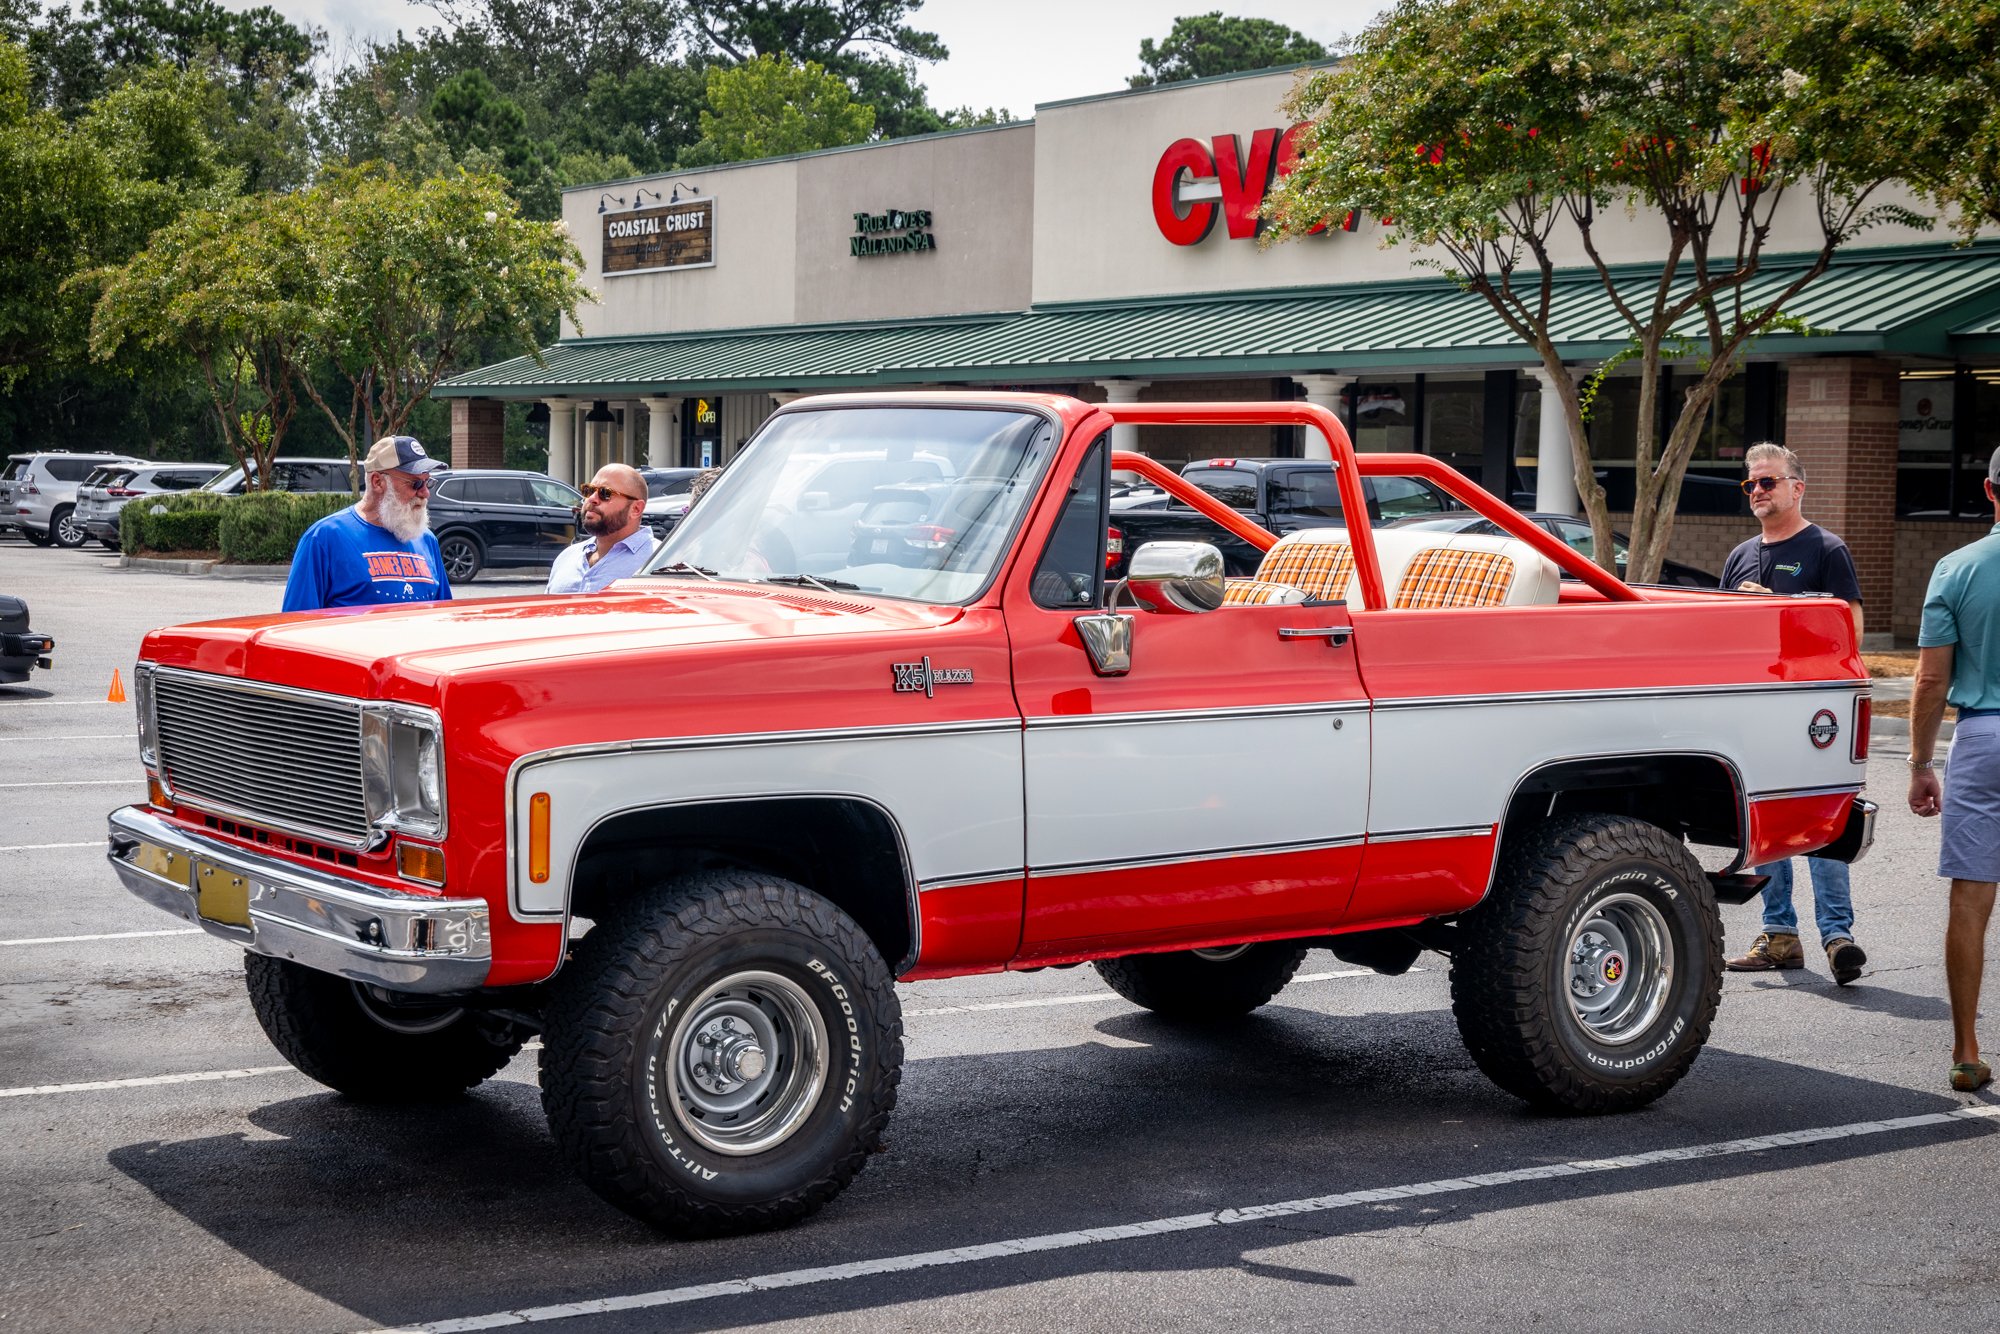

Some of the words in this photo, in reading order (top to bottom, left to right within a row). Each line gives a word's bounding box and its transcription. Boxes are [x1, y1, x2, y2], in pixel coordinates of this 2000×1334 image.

[609, 217, 661, 238] COASTAL
[666, 212, 705, 232] CRUST
[1899, 417, 1953, 432] oneyGra
[368, 557, 402, 576] JAMES
[893, 663, 926, 692] K5
[932, 669, 974, 684] BLAZER
[1565, 870, 1648, 939] All-Terrain
[1654, 876, 1679, 900] T/A
[653, 998, 679, 1040] T/A
[806, 958, 862, 1113] BFGoodrich
[1587, 1016, 1685, 1070] BFGoodrich
[647, 1055, 719, 1181] All-Terrain
